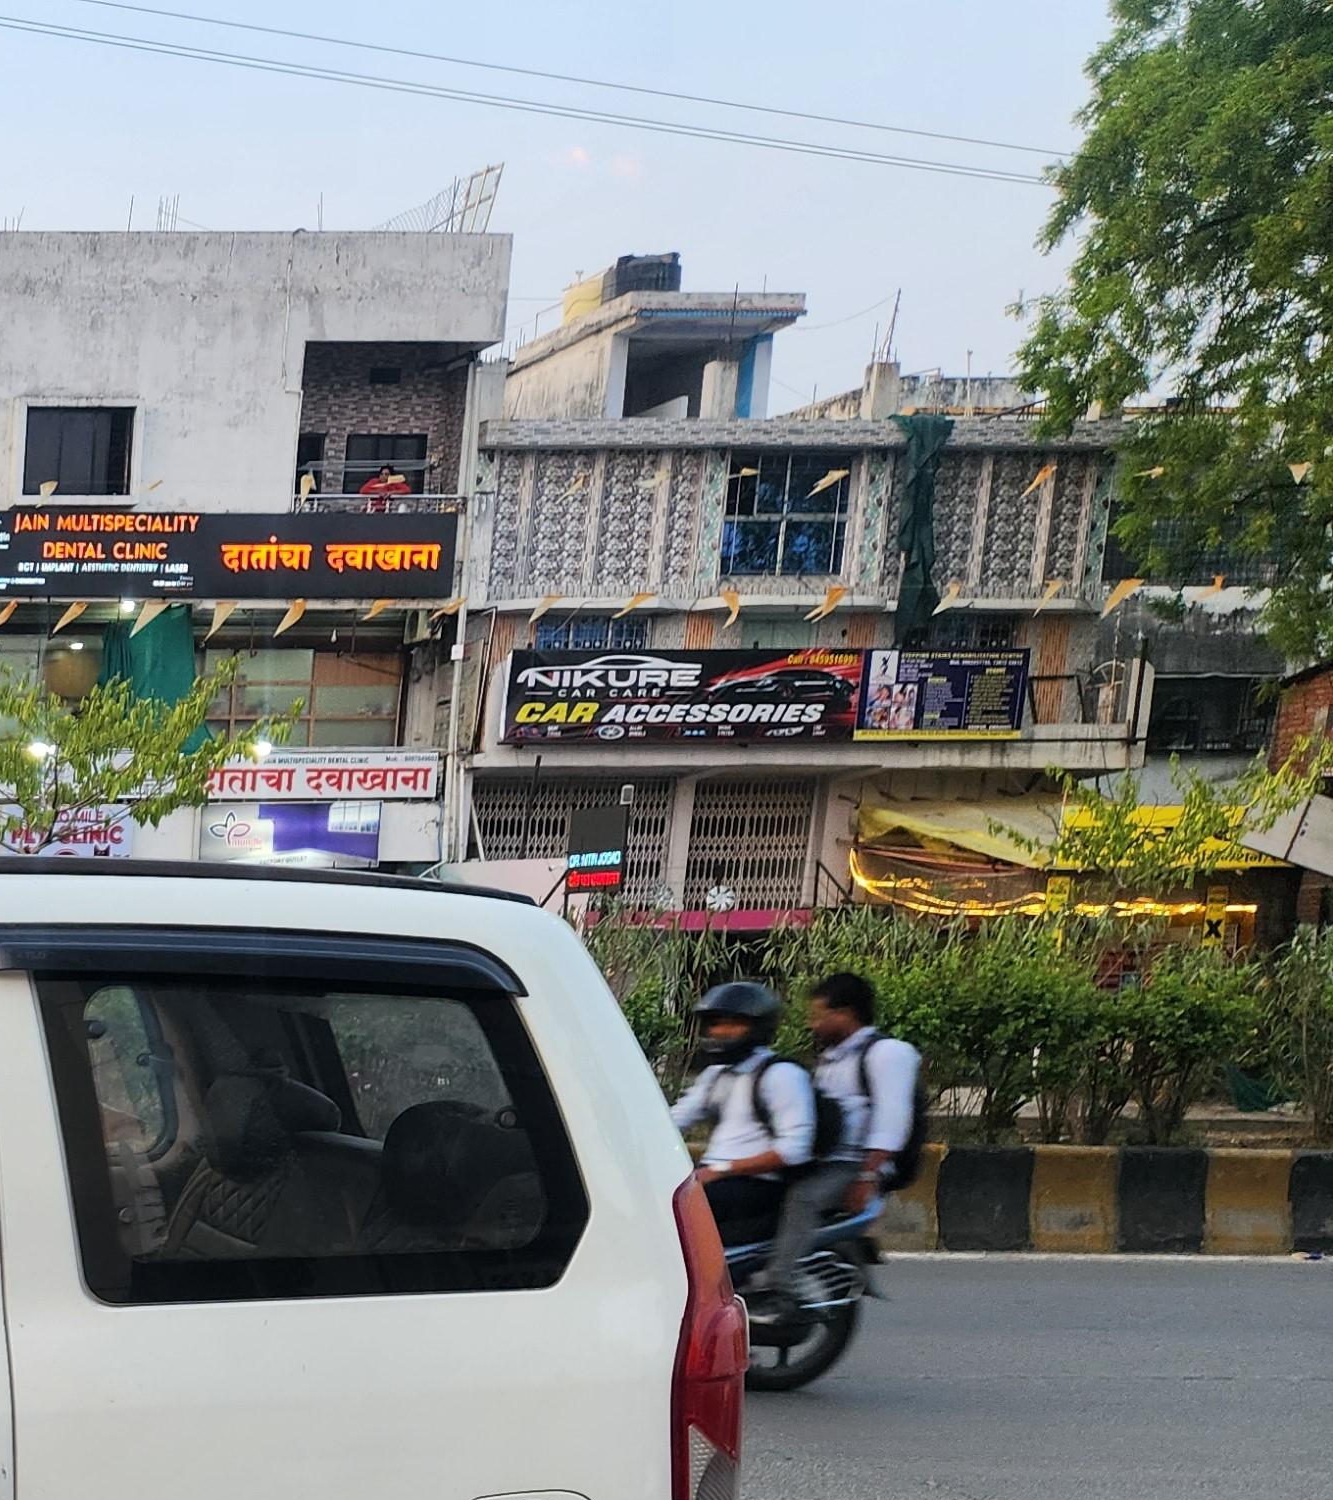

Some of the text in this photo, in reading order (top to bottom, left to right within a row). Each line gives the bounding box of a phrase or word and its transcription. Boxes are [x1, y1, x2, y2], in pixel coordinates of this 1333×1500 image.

[14, 512, 200, 533] JAIN MULTISPECIALITY
[42, 541, 168, 560] DENTAL CLINIC
[220, 535, 441, 573] दातांचा दवाखाना
[41, 562, 74, 573] IMPLANT
[81, 562, 119, 573] AESTHETIC
[121, 562, 159, 573] DENTISTRY
[165, 563, 189, 574] LASER
[523, 668, 701, 688] NIKURE
[557, 688, 661, 698] CAR CARE
[515, 701, 825, 723] CAR ACCESSORIES
[277, 756, 327, 764] MULTISPECIALITY
[306, 766, 432, 795] दवाखाना
